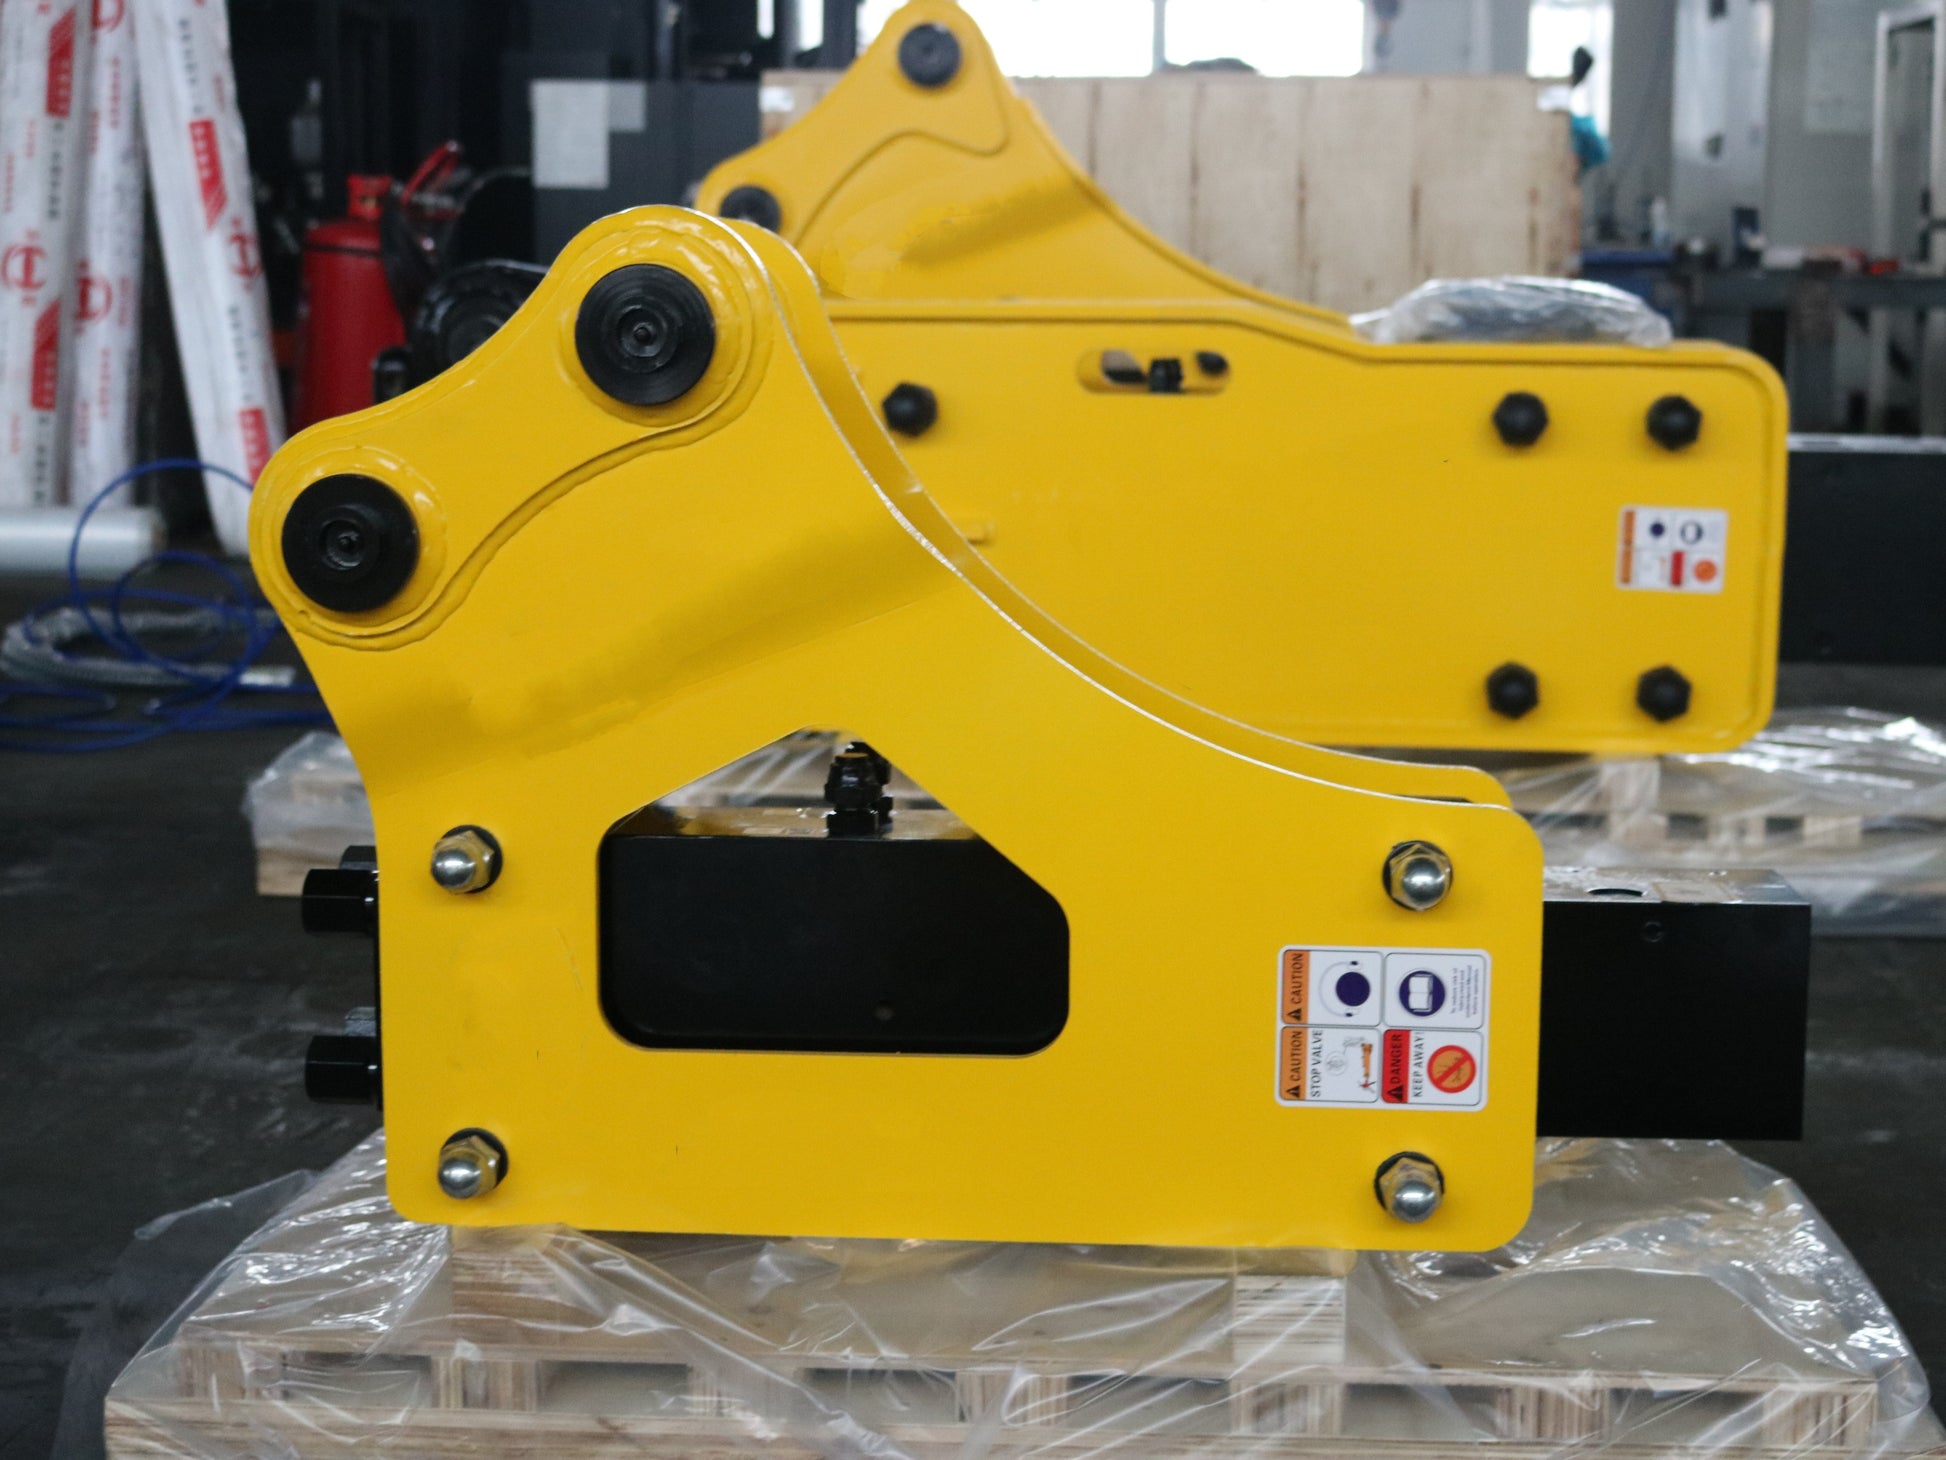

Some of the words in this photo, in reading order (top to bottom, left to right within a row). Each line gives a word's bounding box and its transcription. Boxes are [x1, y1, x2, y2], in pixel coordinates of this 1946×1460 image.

[1290, 952, 1303, 1004] CAUTION
[1289, 1030, 1302, 1081] CAUTION
[1311, 1029, 1323, 1066] VALVE
[1389, 1033, 1402, 1085] DANGER
[1311, 1068, 1321, 1097] STOP
[1412, 1071, 1423, 1097] KEEP
